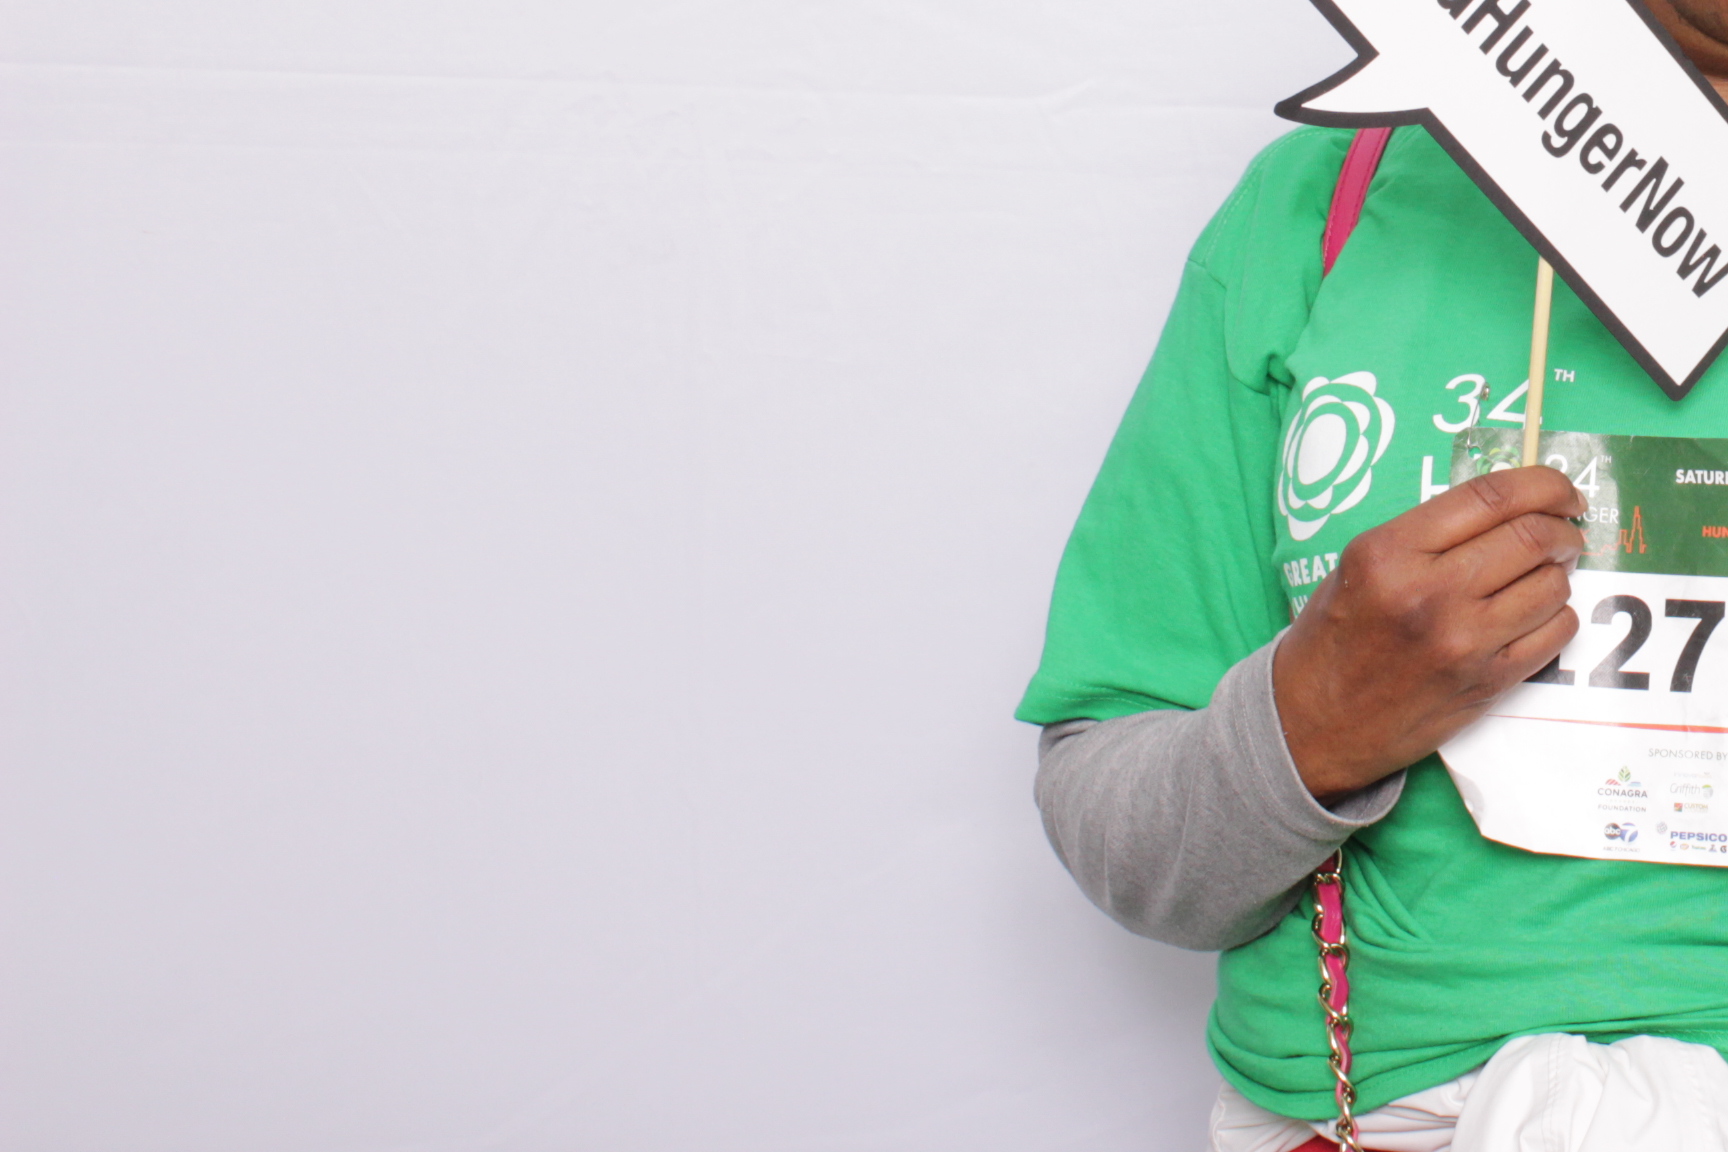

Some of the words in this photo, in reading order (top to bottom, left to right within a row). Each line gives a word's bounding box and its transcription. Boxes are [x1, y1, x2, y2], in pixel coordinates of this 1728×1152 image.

[1283, 552, 1338, 587] GREAT
[1648, 748, 1714, 761] SPONSORED
[1597, 787, 1648, 799] CONAGRA
[1597, 804, 1647, 813] FOUNDATION
[1604, 826, 1621, 836] abc
[1670, 830, 1728, 843] PEPSICO
